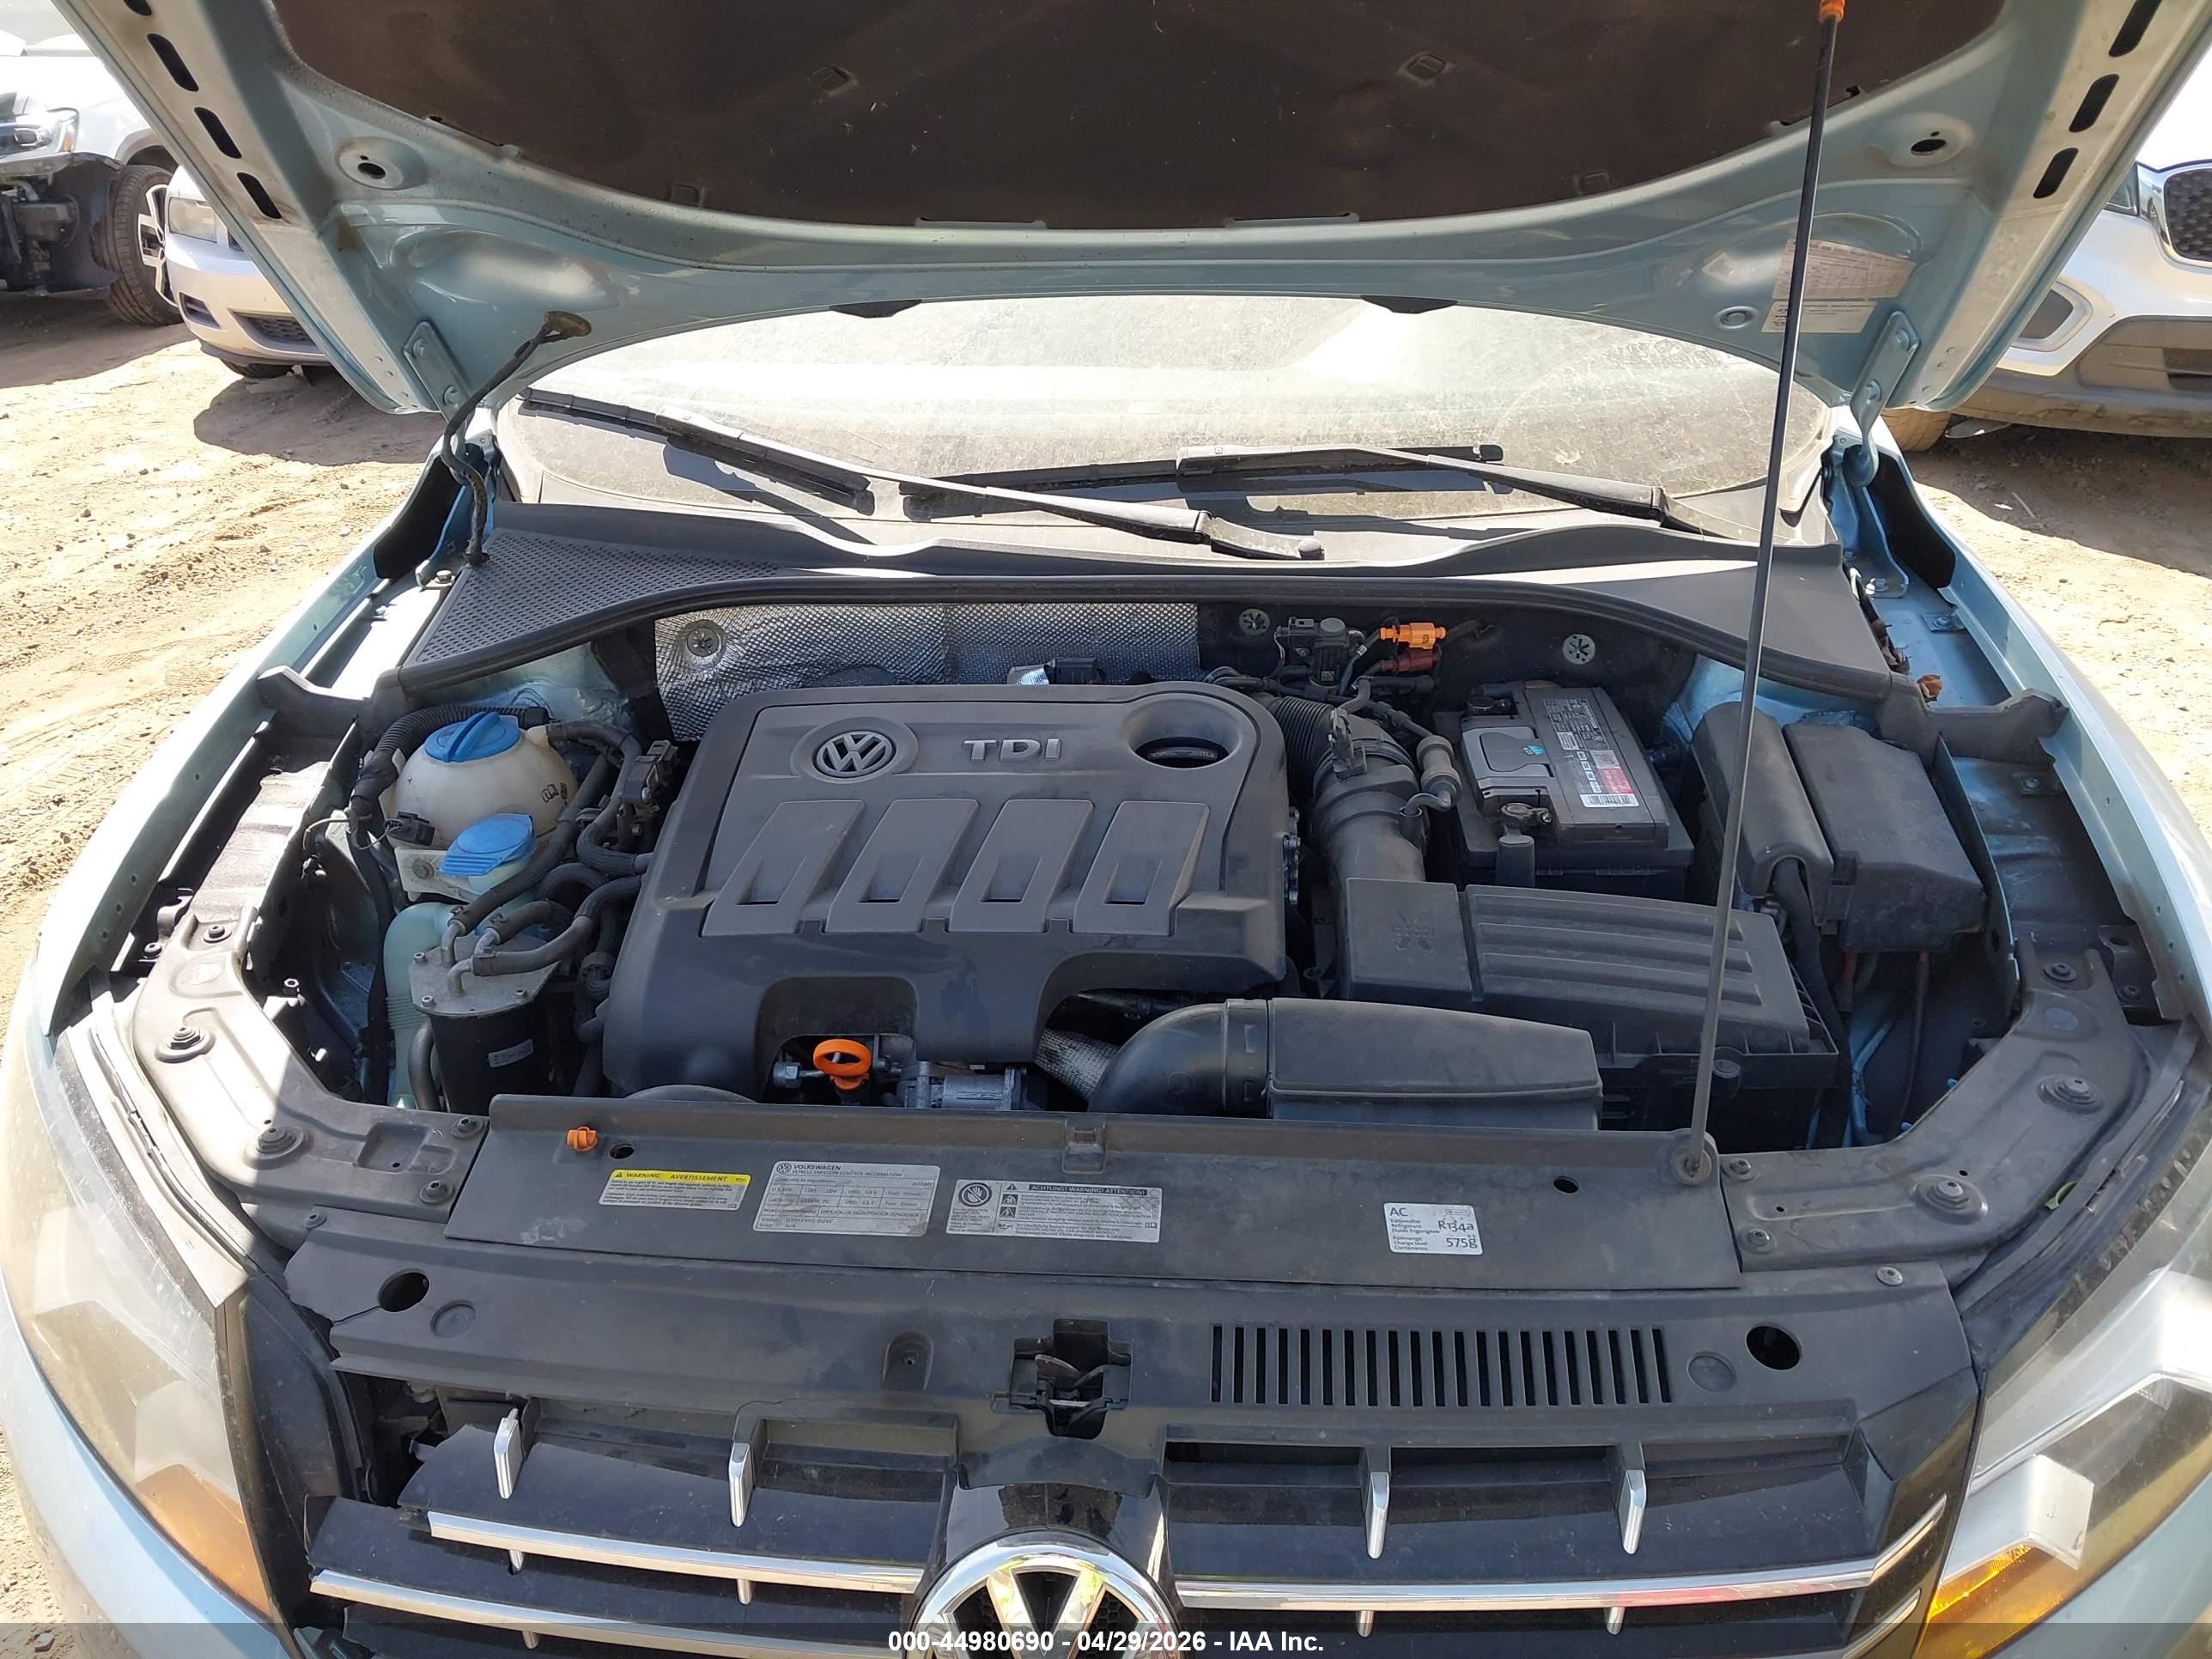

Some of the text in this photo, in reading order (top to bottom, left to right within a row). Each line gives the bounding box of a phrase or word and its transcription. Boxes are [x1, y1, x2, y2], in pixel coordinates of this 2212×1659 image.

[963, 737, 1061, 763] TDI
[1389, 1207, 1408, 1217] AC
[1437, 1220, 1474, 1232] R134a
[1446, 1237, 1478, 1249] 575g
